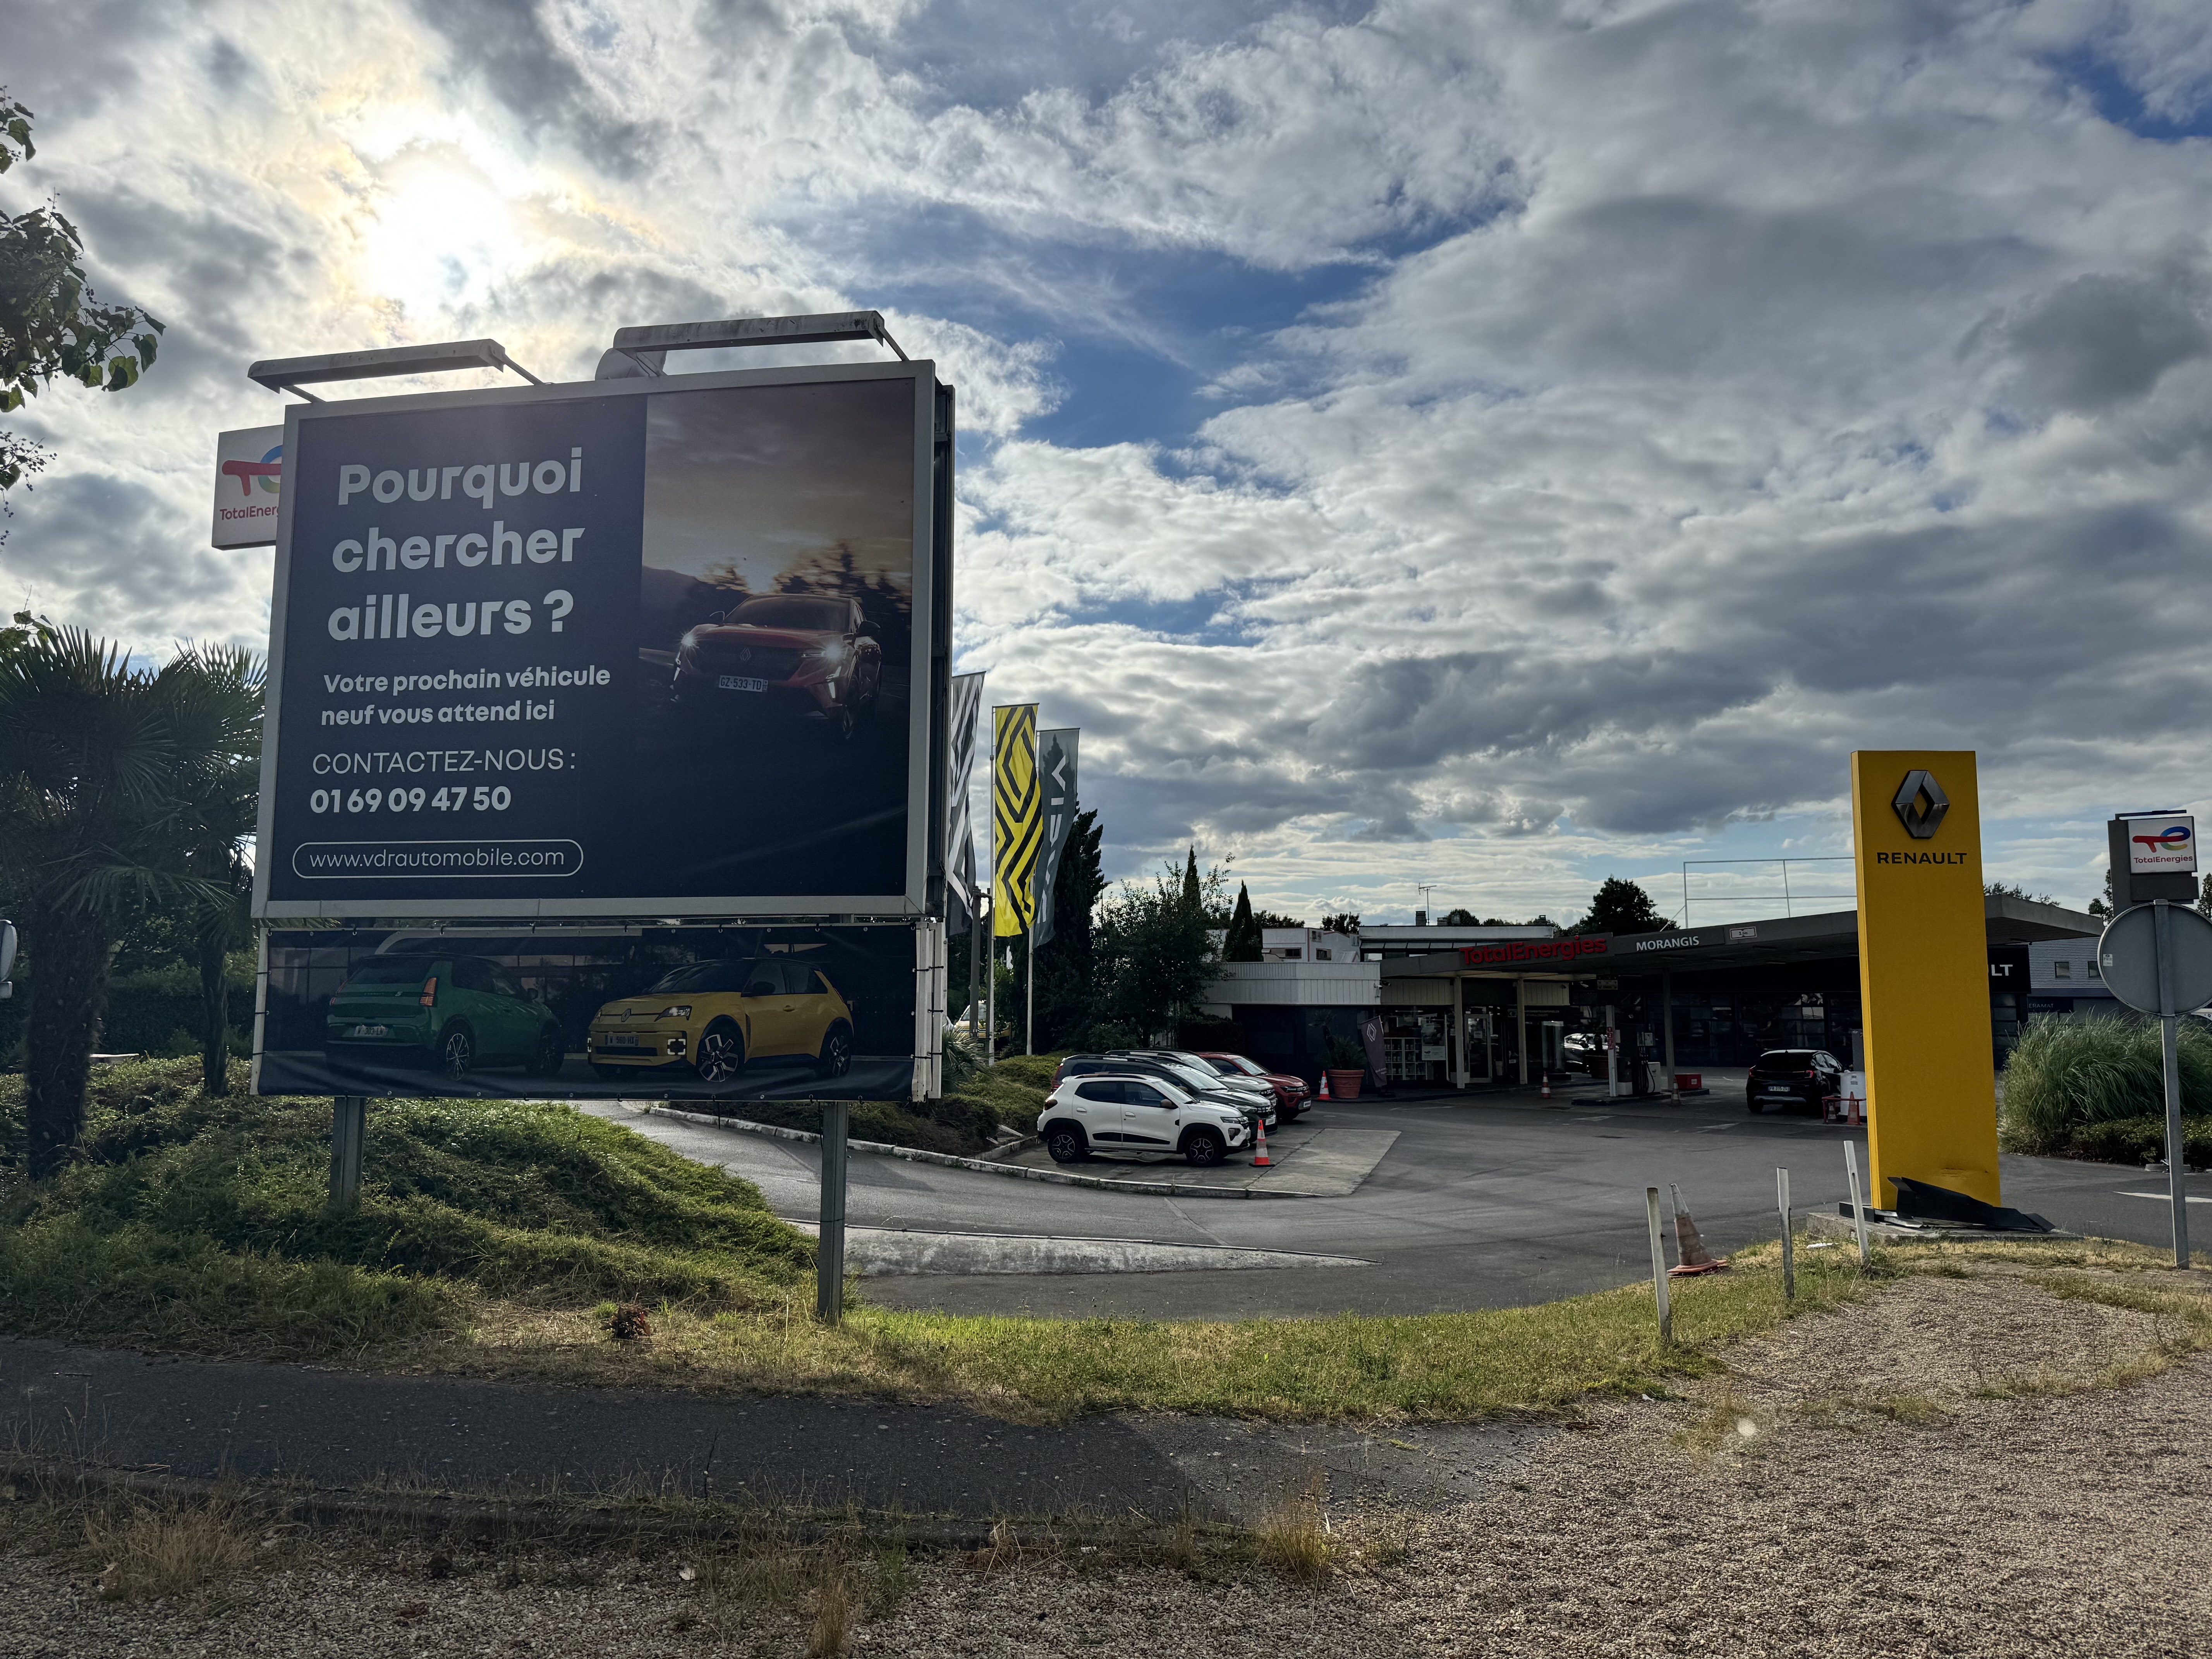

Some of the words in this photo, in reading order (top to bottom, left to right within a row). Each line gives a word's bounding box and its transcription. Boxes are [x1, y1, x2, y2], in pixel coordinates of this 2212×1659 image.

[338, 447, 581, 509] Pourquoi
[220, 506, 278, 520] TotalEner
[333, 520, 585, 572] chercher
[328, 594, 531, 640] ailleurs
[543, 590, 573, 632] ?
[324, 674, 388, 692] Votre
[393, 668, 500, 696] prochain
[506, 665, 610, 687] véhicule
[721, 677, 761, 690] GZ-533-TD
[322, 705, 375, 725] neuf
[378, 708, 433, 723] vous
[438, 701, 520, 722] attend
[526, 699, 554, 720] ici
[313, 749, 563, 774] CONTACTEZ-NOUS
[311, 790, 340, 813] 01
[347, 788, 382, 812] 69
[388, 788, 426, 812] 09
[432, 787, 467, 811] 47
[473, 786, 511, 811] 50
[310, 848, 564, 867] www.vdrautomobile.com
[1877, 852, 1967, 864] RENAULT
[2133, 855, 2193, 864] TotalEnergies
[1459, 936, 1607, 964] TotalEnergies
[1637, 936, 1699, 951] MORANGIS
